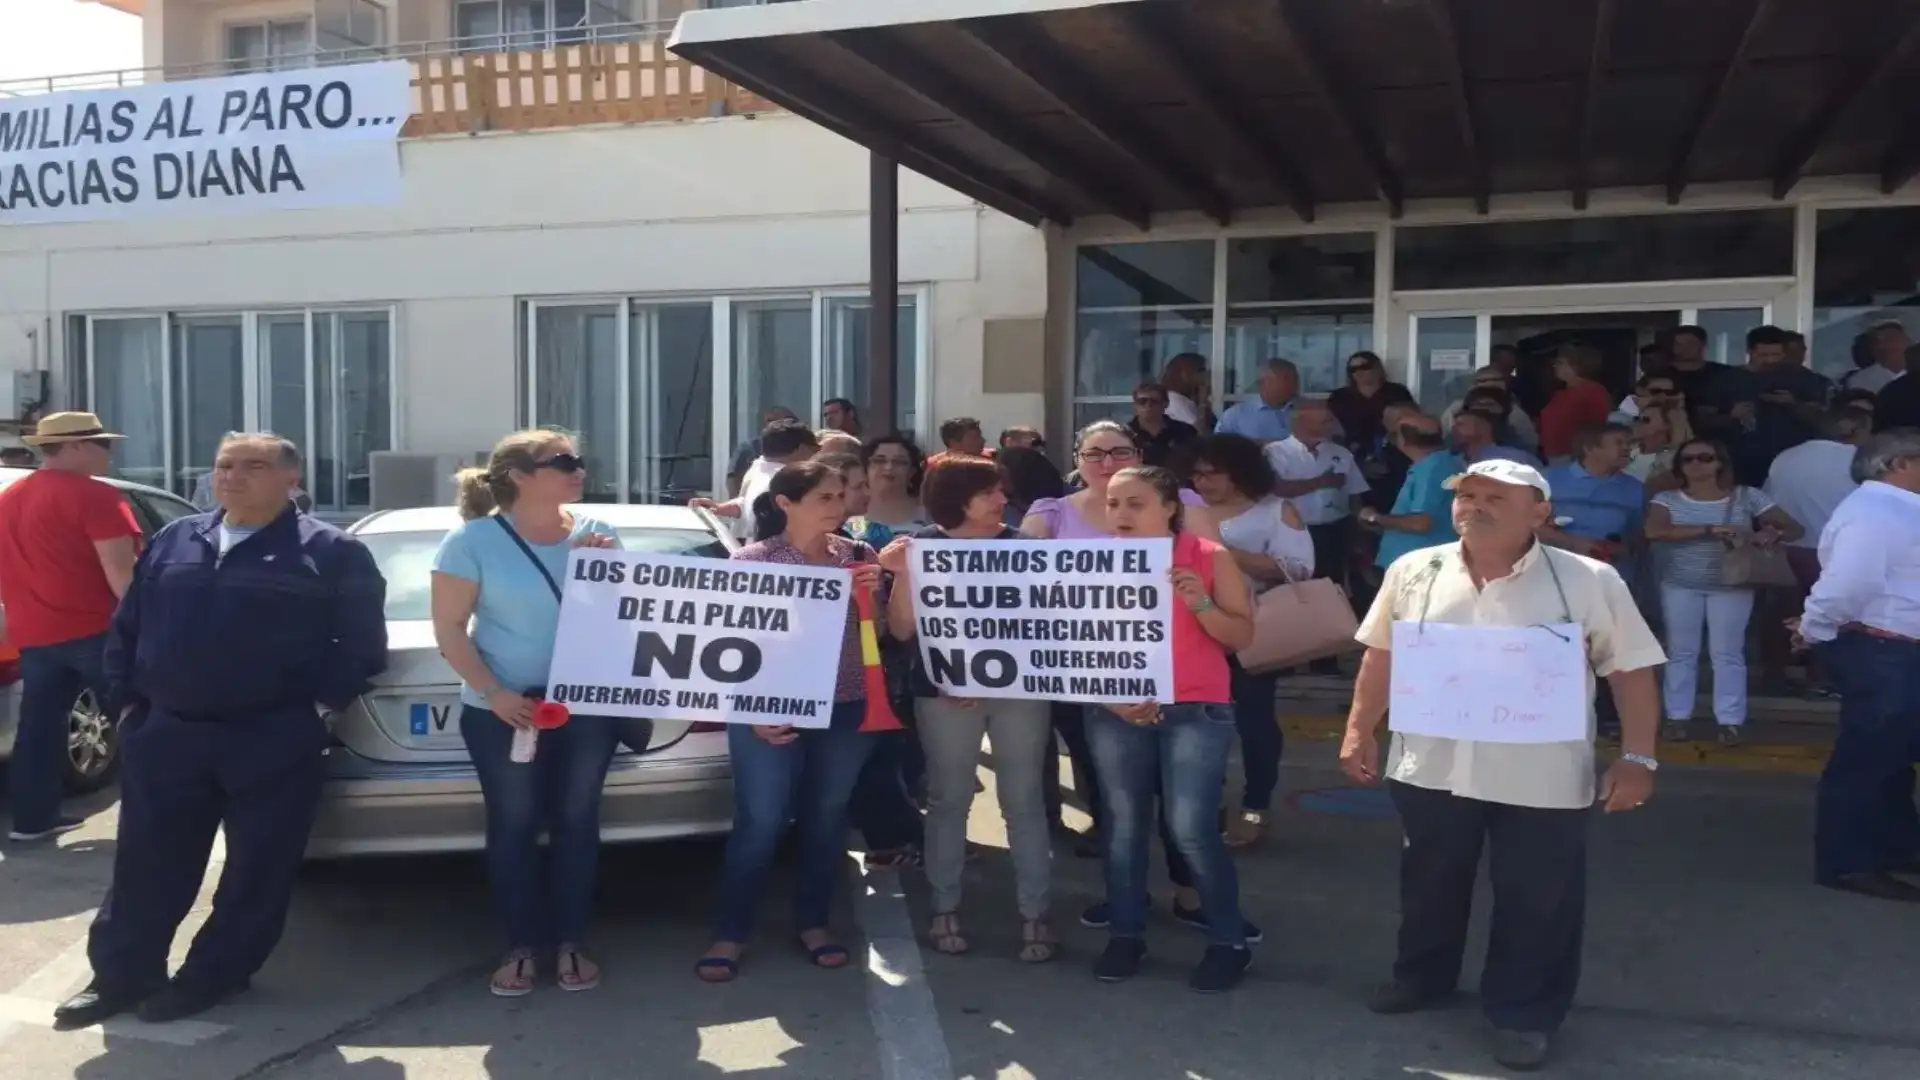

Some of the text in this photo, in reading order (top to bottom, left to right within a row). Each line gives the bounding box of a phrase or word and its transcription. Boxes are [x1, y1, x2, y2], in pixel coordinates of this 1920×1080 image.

[0, 80, 396, 152] MILIAS AL PARO...
[0, 144, 305, 209] ACIAS DIANA
[922, 549, 1152, 573] ESTAMOS CON EL
[574, 558, 842, 601] LOS COMERCIANTES
[919, 581, 1158, 610] CLUB NÁUTICO
[618, 597, 789, 632] DE LA PLAYA
[921, 617, 1164, 642] LOS COMERCIANTES
[631, 631, 762, 683] NO
[928, 647, 1018, 688] NO
[1030, 649, 1147, 670] QUEREMOS
[552, 684, 827, 717] QUEREMOS UNA "MARINA"
[1023, 675, 1157, 697] UNA MARINA
